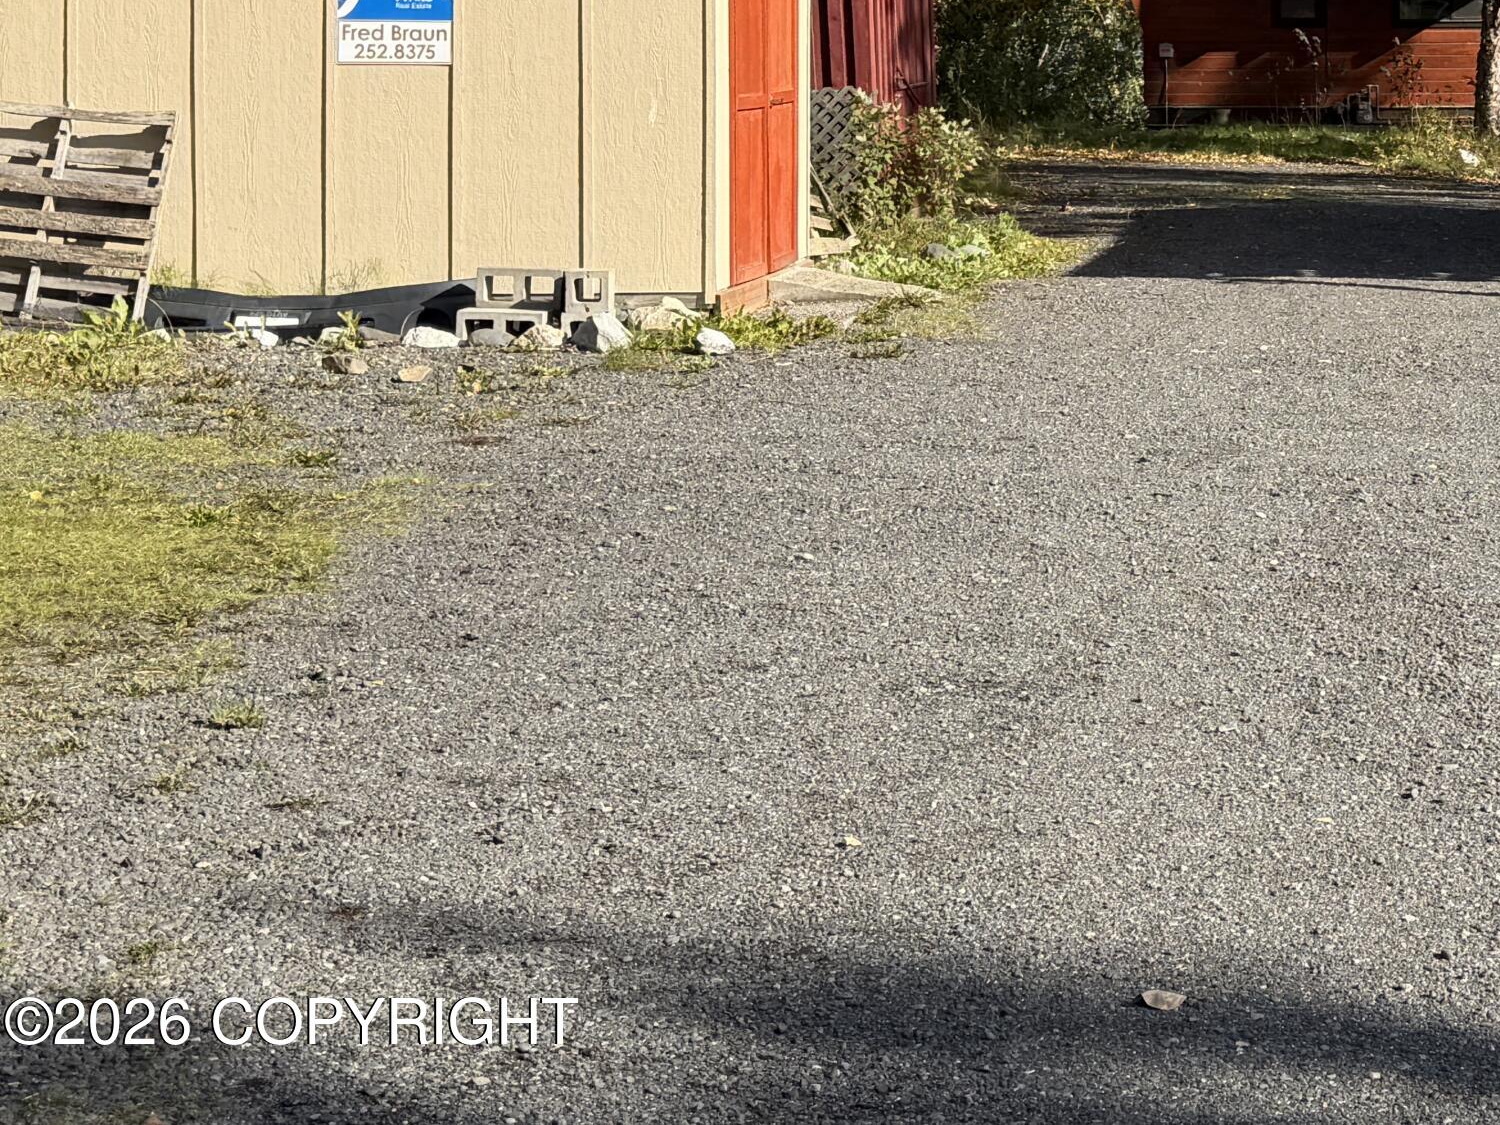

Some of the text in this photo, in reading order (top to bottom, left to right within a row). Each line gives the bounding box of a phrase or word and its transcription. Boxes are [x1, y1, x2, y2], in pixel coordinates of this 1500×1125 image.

[341, 24, 448, 42] Fred Braun
[354, 43, 436, 60] 252.8375
